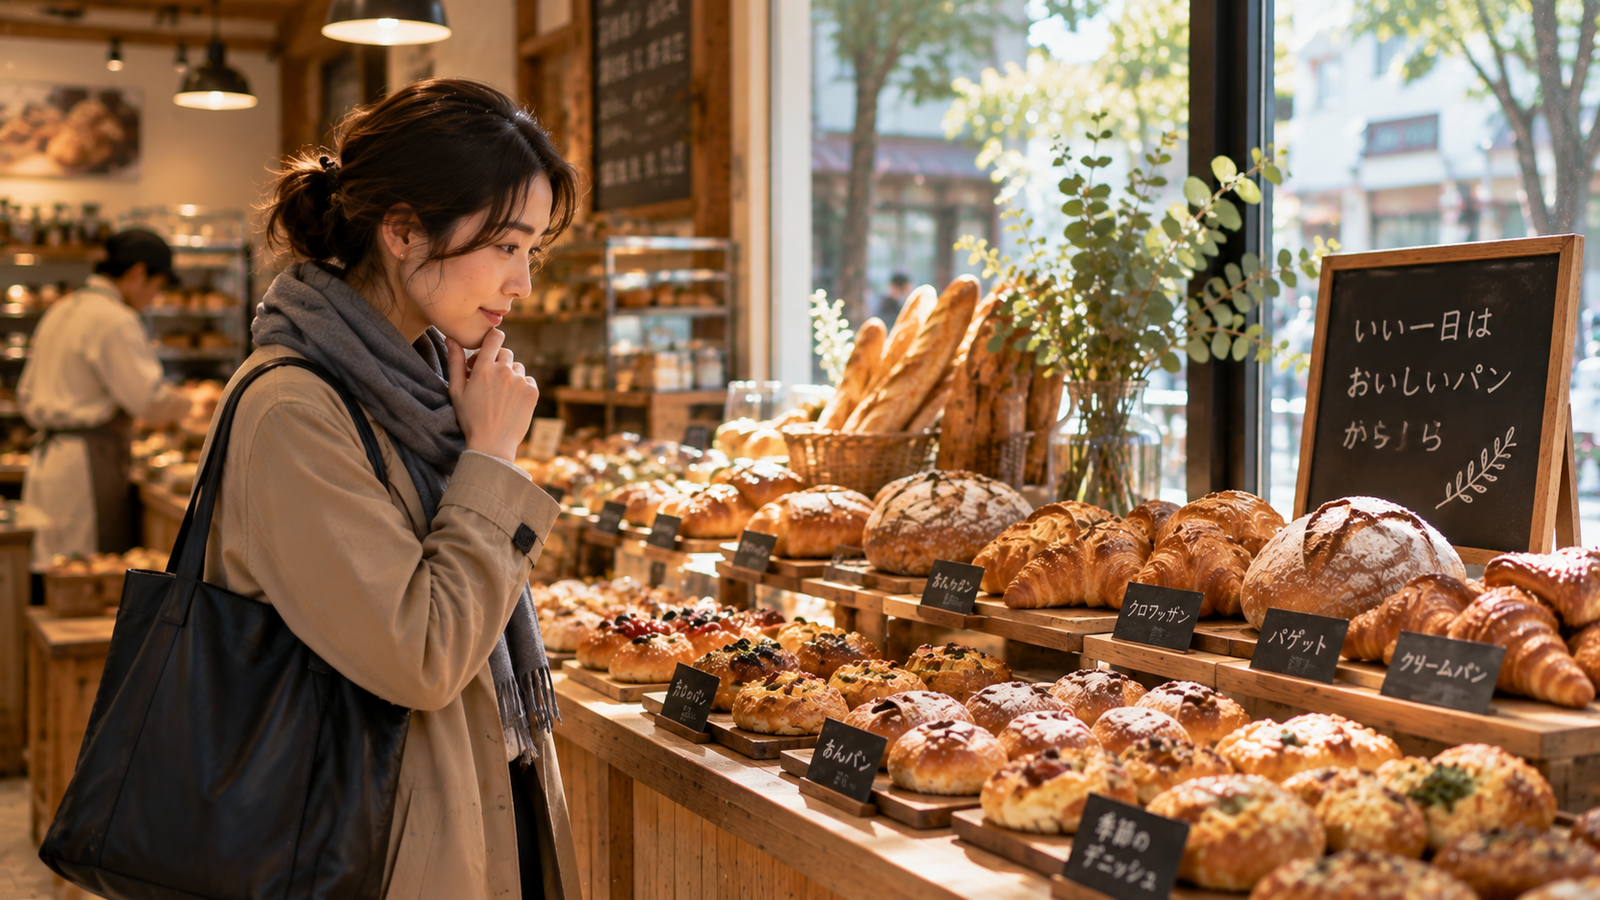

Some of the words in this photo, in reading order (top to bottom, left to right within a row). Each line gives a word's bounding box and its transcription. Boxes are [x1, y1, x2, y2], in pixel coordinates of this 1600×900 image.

[1355, 308, 1492, 342] いい一日は
[1347, 364, 1511, 398] おいしいパン
[1399, 651, 1488, 683] クリームパン
[822, 739, 871, 771] あんパン
[1094, 811, 1151, 853] 季節の
[1082, 843, 1157, 892] デニッシュ
